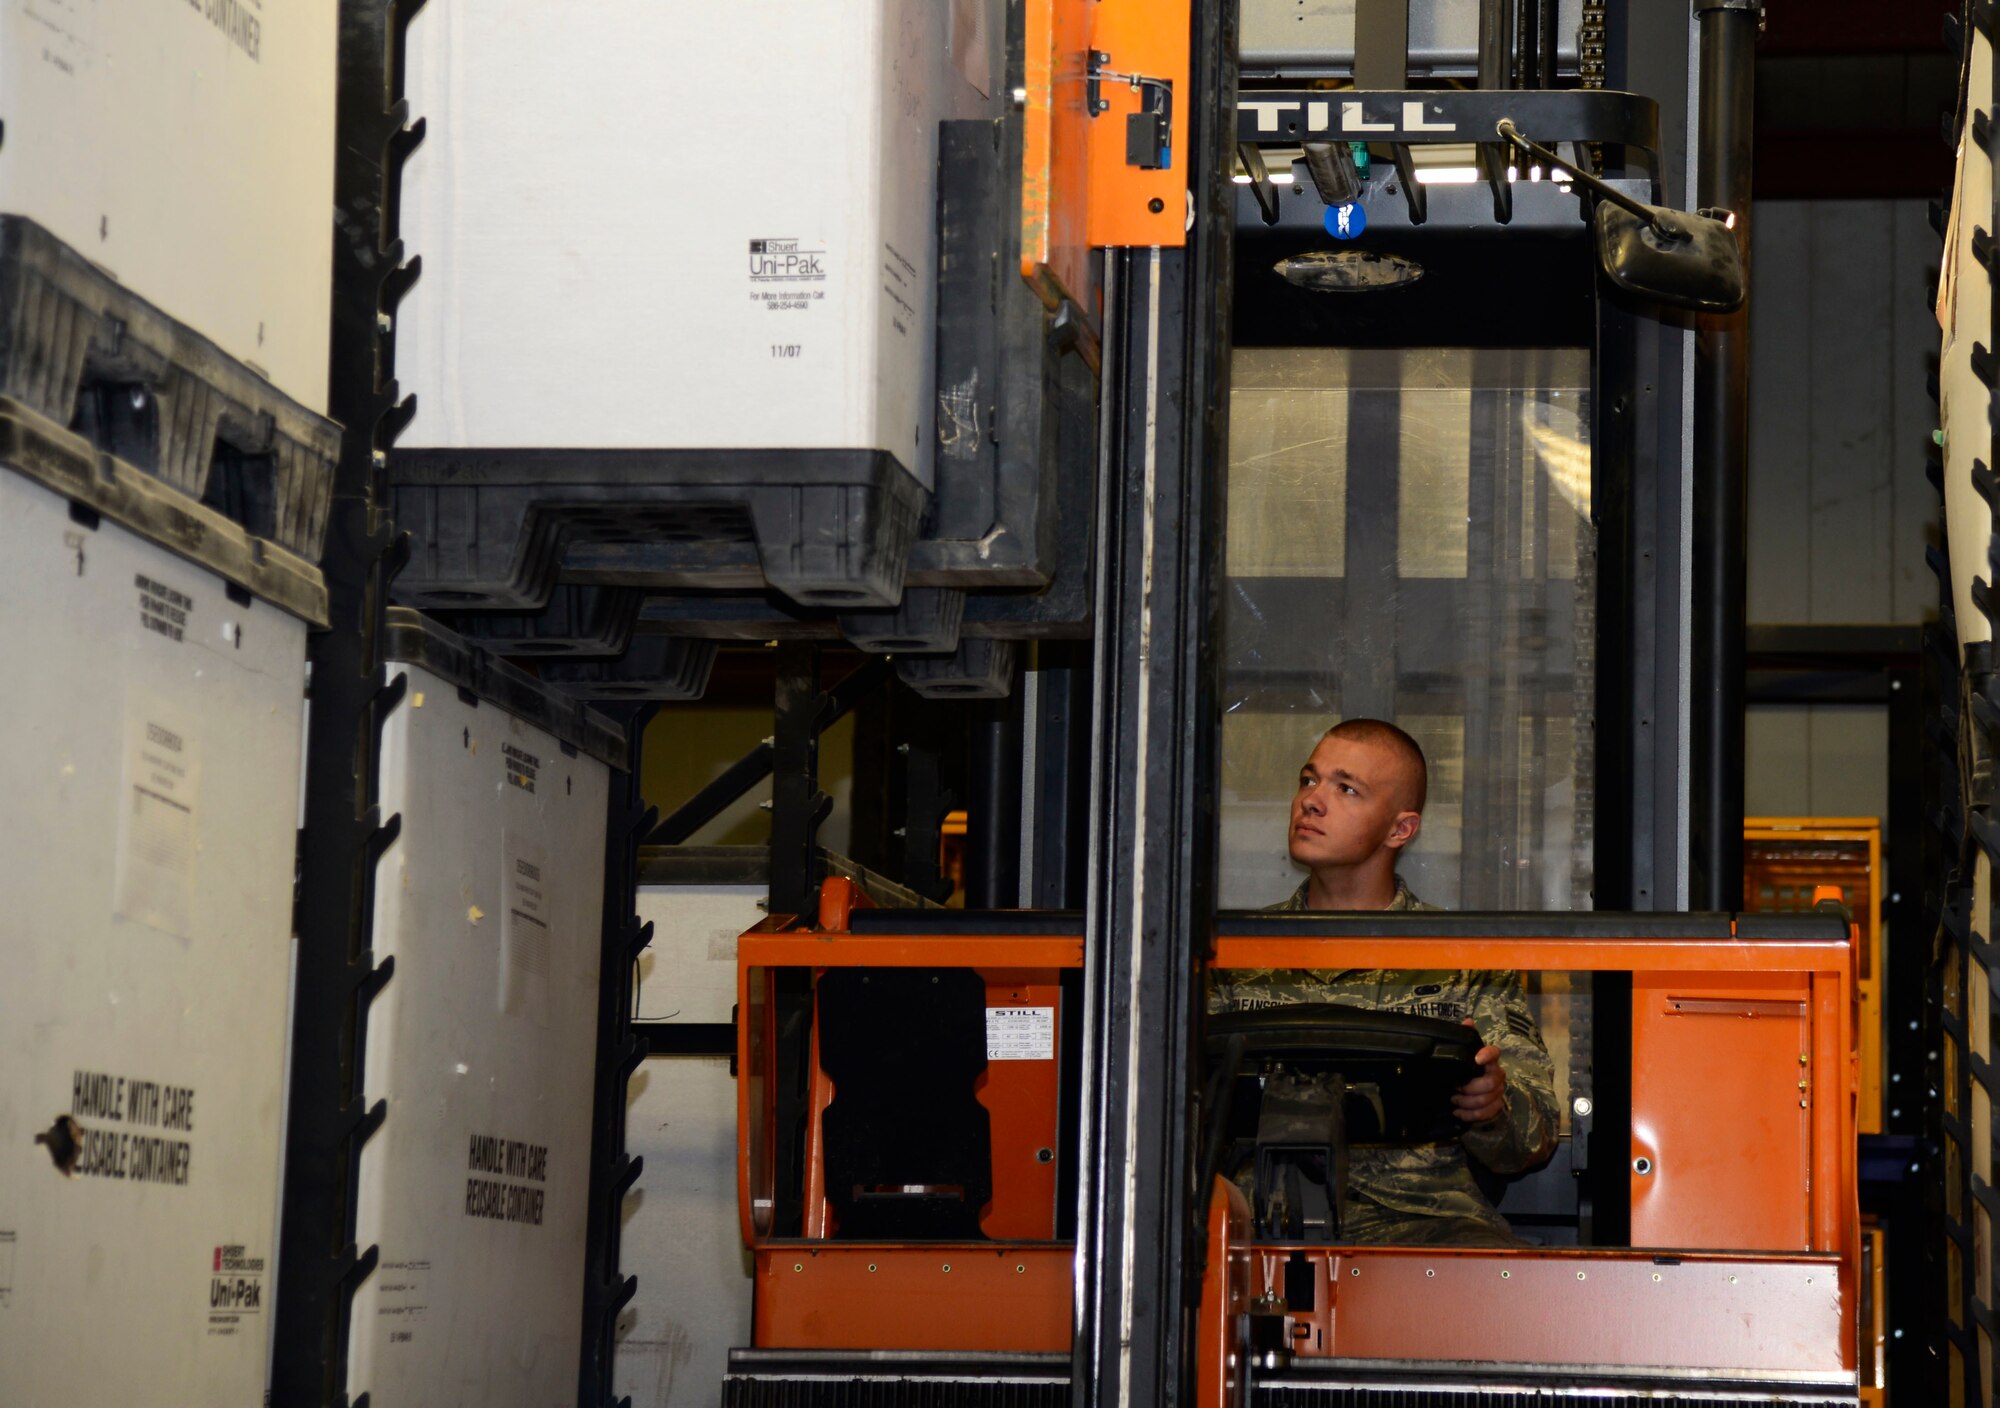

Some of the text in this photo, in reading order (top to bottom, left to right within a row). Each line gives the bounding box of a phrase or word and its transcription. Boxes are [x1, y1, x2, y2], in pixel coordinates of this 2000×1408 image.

[1237, 102, 1456, 131] TILL
[768, 241, 797, 252] Shuert
[750, 291, 759, 300] For
[761, 291, 777, 300] More
[779, 290, 811, 300] Information
[771, 345, 801, 357] 11/07
[1411, 1003, 1428, 1016] AIR
[1431, 1002, 1459, 1017] FORCE
[72, 1070, 194, 1131] HANDLE WITH CARE
[130, 1135, 190, 1186] CONTAINER
[469, 1134, 548, 1182] HANDLE WITH CARE
[465, 1178, 544, 1226] REUSABLE CONTAINER
[210, 1278, 261, 1308] Uni-Pak
